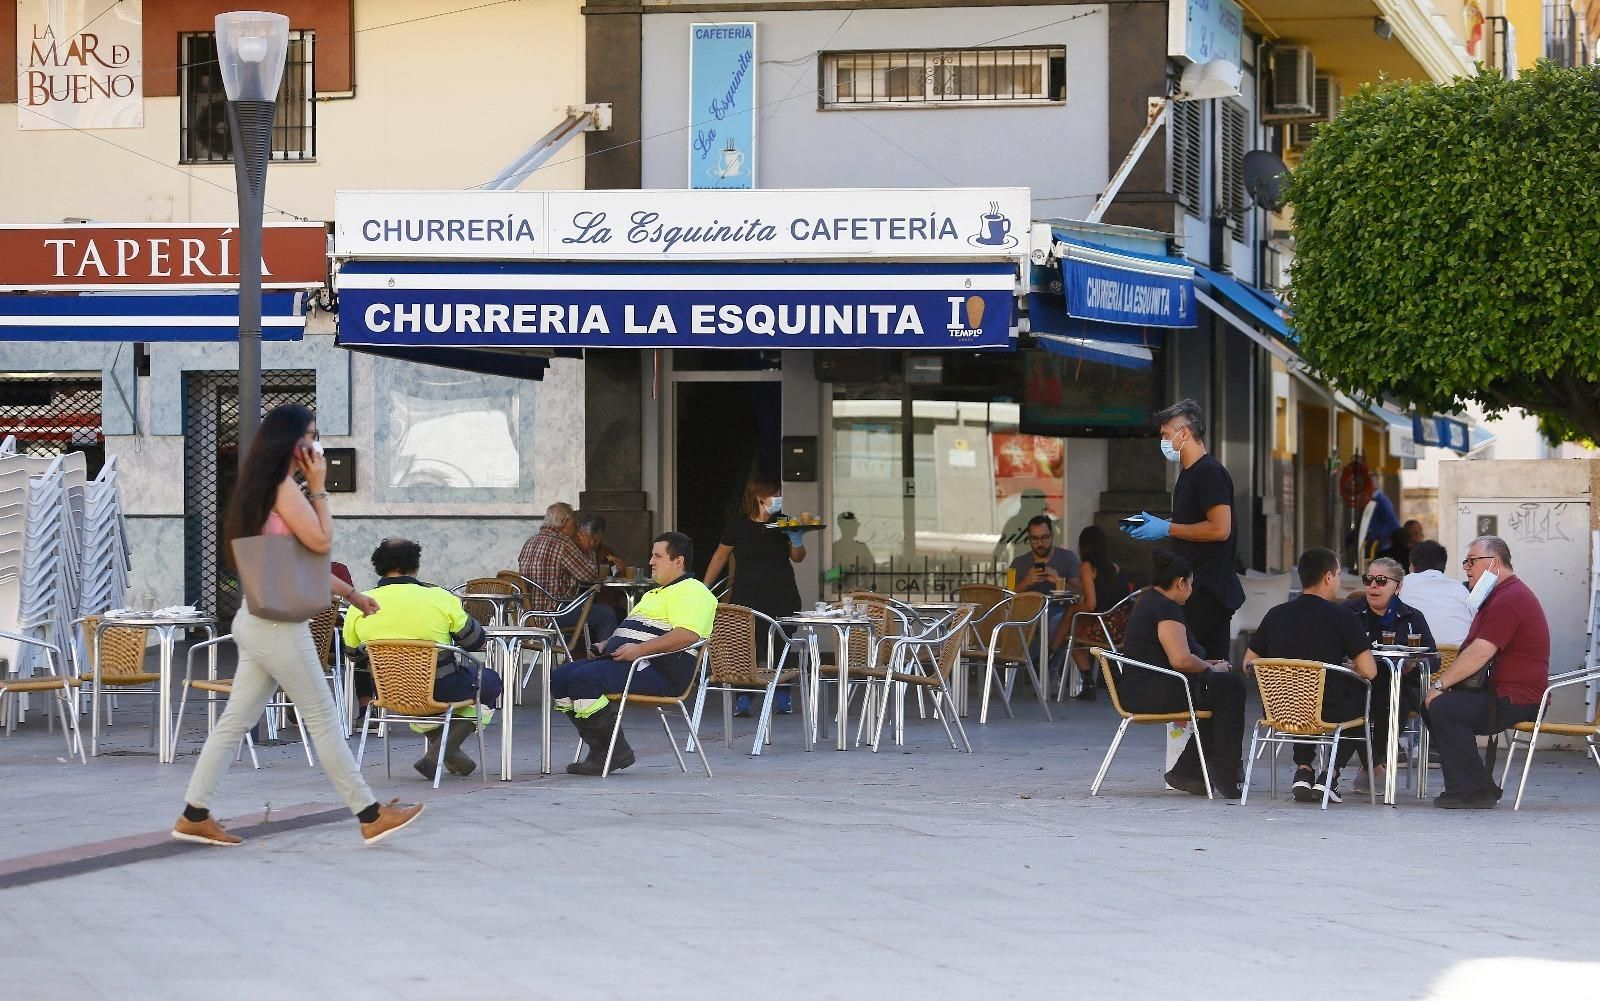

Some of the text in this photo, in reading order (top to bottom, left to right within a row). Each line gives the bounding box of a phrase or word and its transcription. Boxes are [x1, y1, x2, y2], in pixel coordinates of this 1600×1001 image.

[33, 24, 55, 39] LA
[696, 26, 752, 40] CAFETERÍA
[28, 33, 128, 68] MAR
[26, 70, 135, 106] BUENO
[694, 49, 753, 159] La Esquinita
[362, 211, 959, 252] CHURRERÍA La Esquinita CAFETERÍA
[44, 228, 273, 277] TAPERÍ
[947, 296, 965, 330] I
[1087, 277, 1169, 315] CHURRERIA LA ESQUINITA
[364, 303, 924, 336] CHURRERIA LA ESQUINITA
[949, 328, 983, 337] TEMPLO
